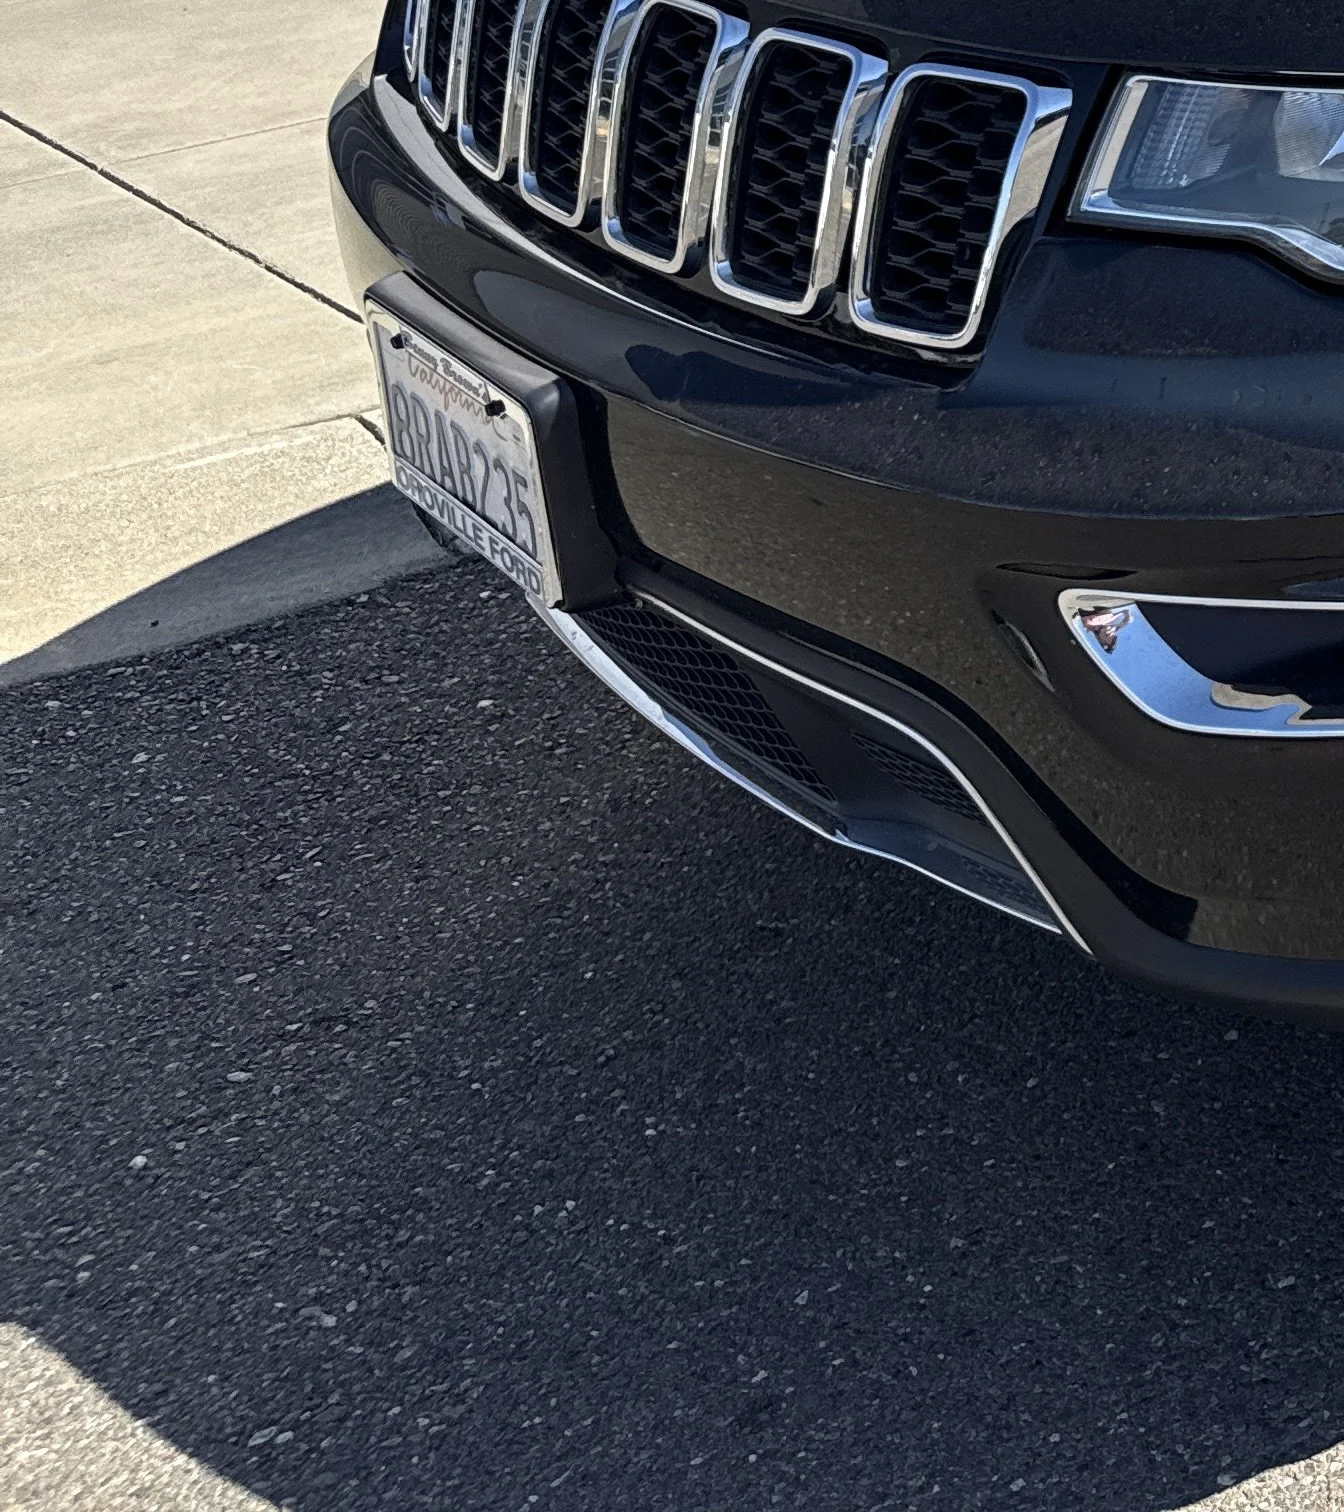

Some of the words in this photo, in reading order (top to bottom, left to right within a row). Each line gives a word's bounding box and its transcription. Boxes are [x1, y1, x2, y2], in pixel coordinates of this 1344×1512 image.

[391, 381, 538, 561] 8RAB235
[395, 464, 486, 553] OROVILLE
[488, 534, 542, 597] FORD
